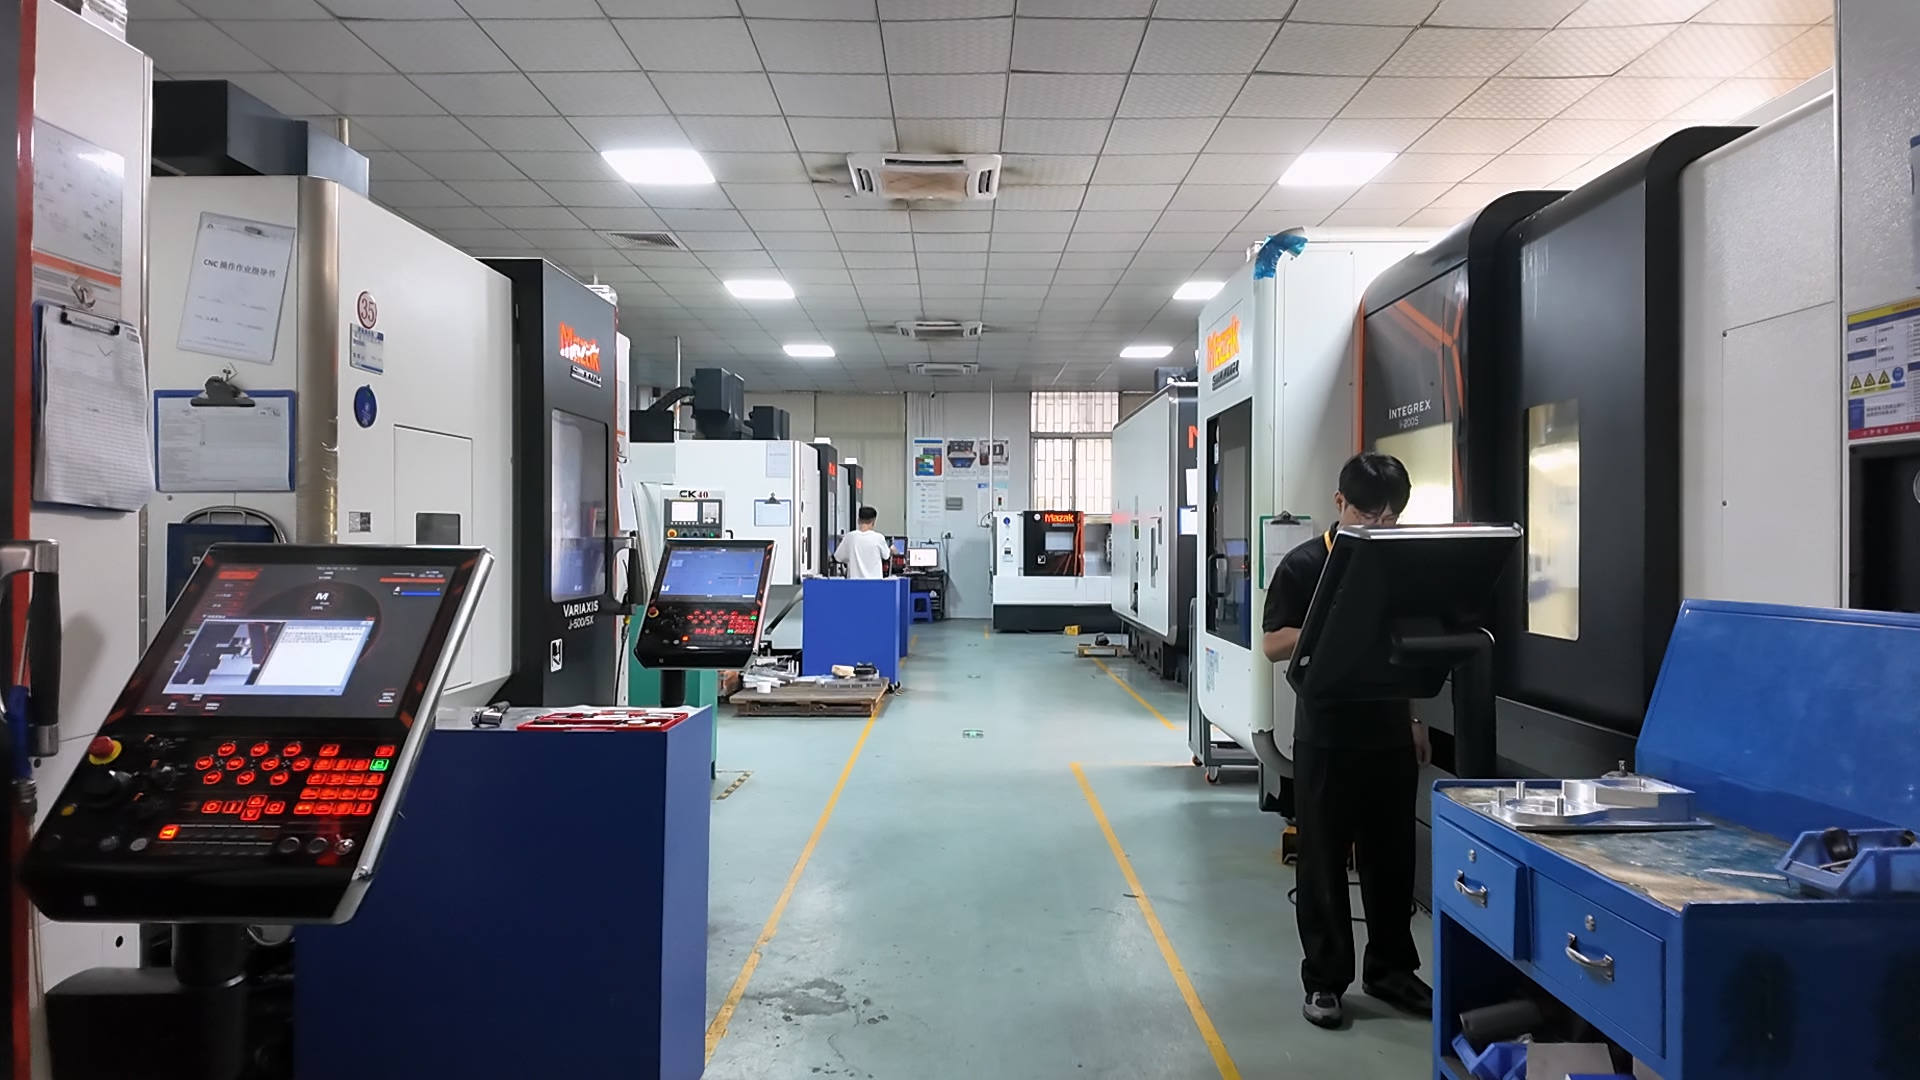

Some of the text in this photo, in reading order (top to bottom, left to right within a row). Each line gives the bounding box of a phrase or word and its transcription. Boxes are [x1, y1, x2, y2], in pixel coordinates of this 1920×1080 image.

[203, 258, 219, 268] CNC
[361, 298, 375, 322] 35
[1388, 399, 1431, 420] INTEGREX
[679, 490, 709, 499] CK 40
[1044, 513, 1075, 524] Mazak
[562, 600, 599, 618] VARIAXIS
